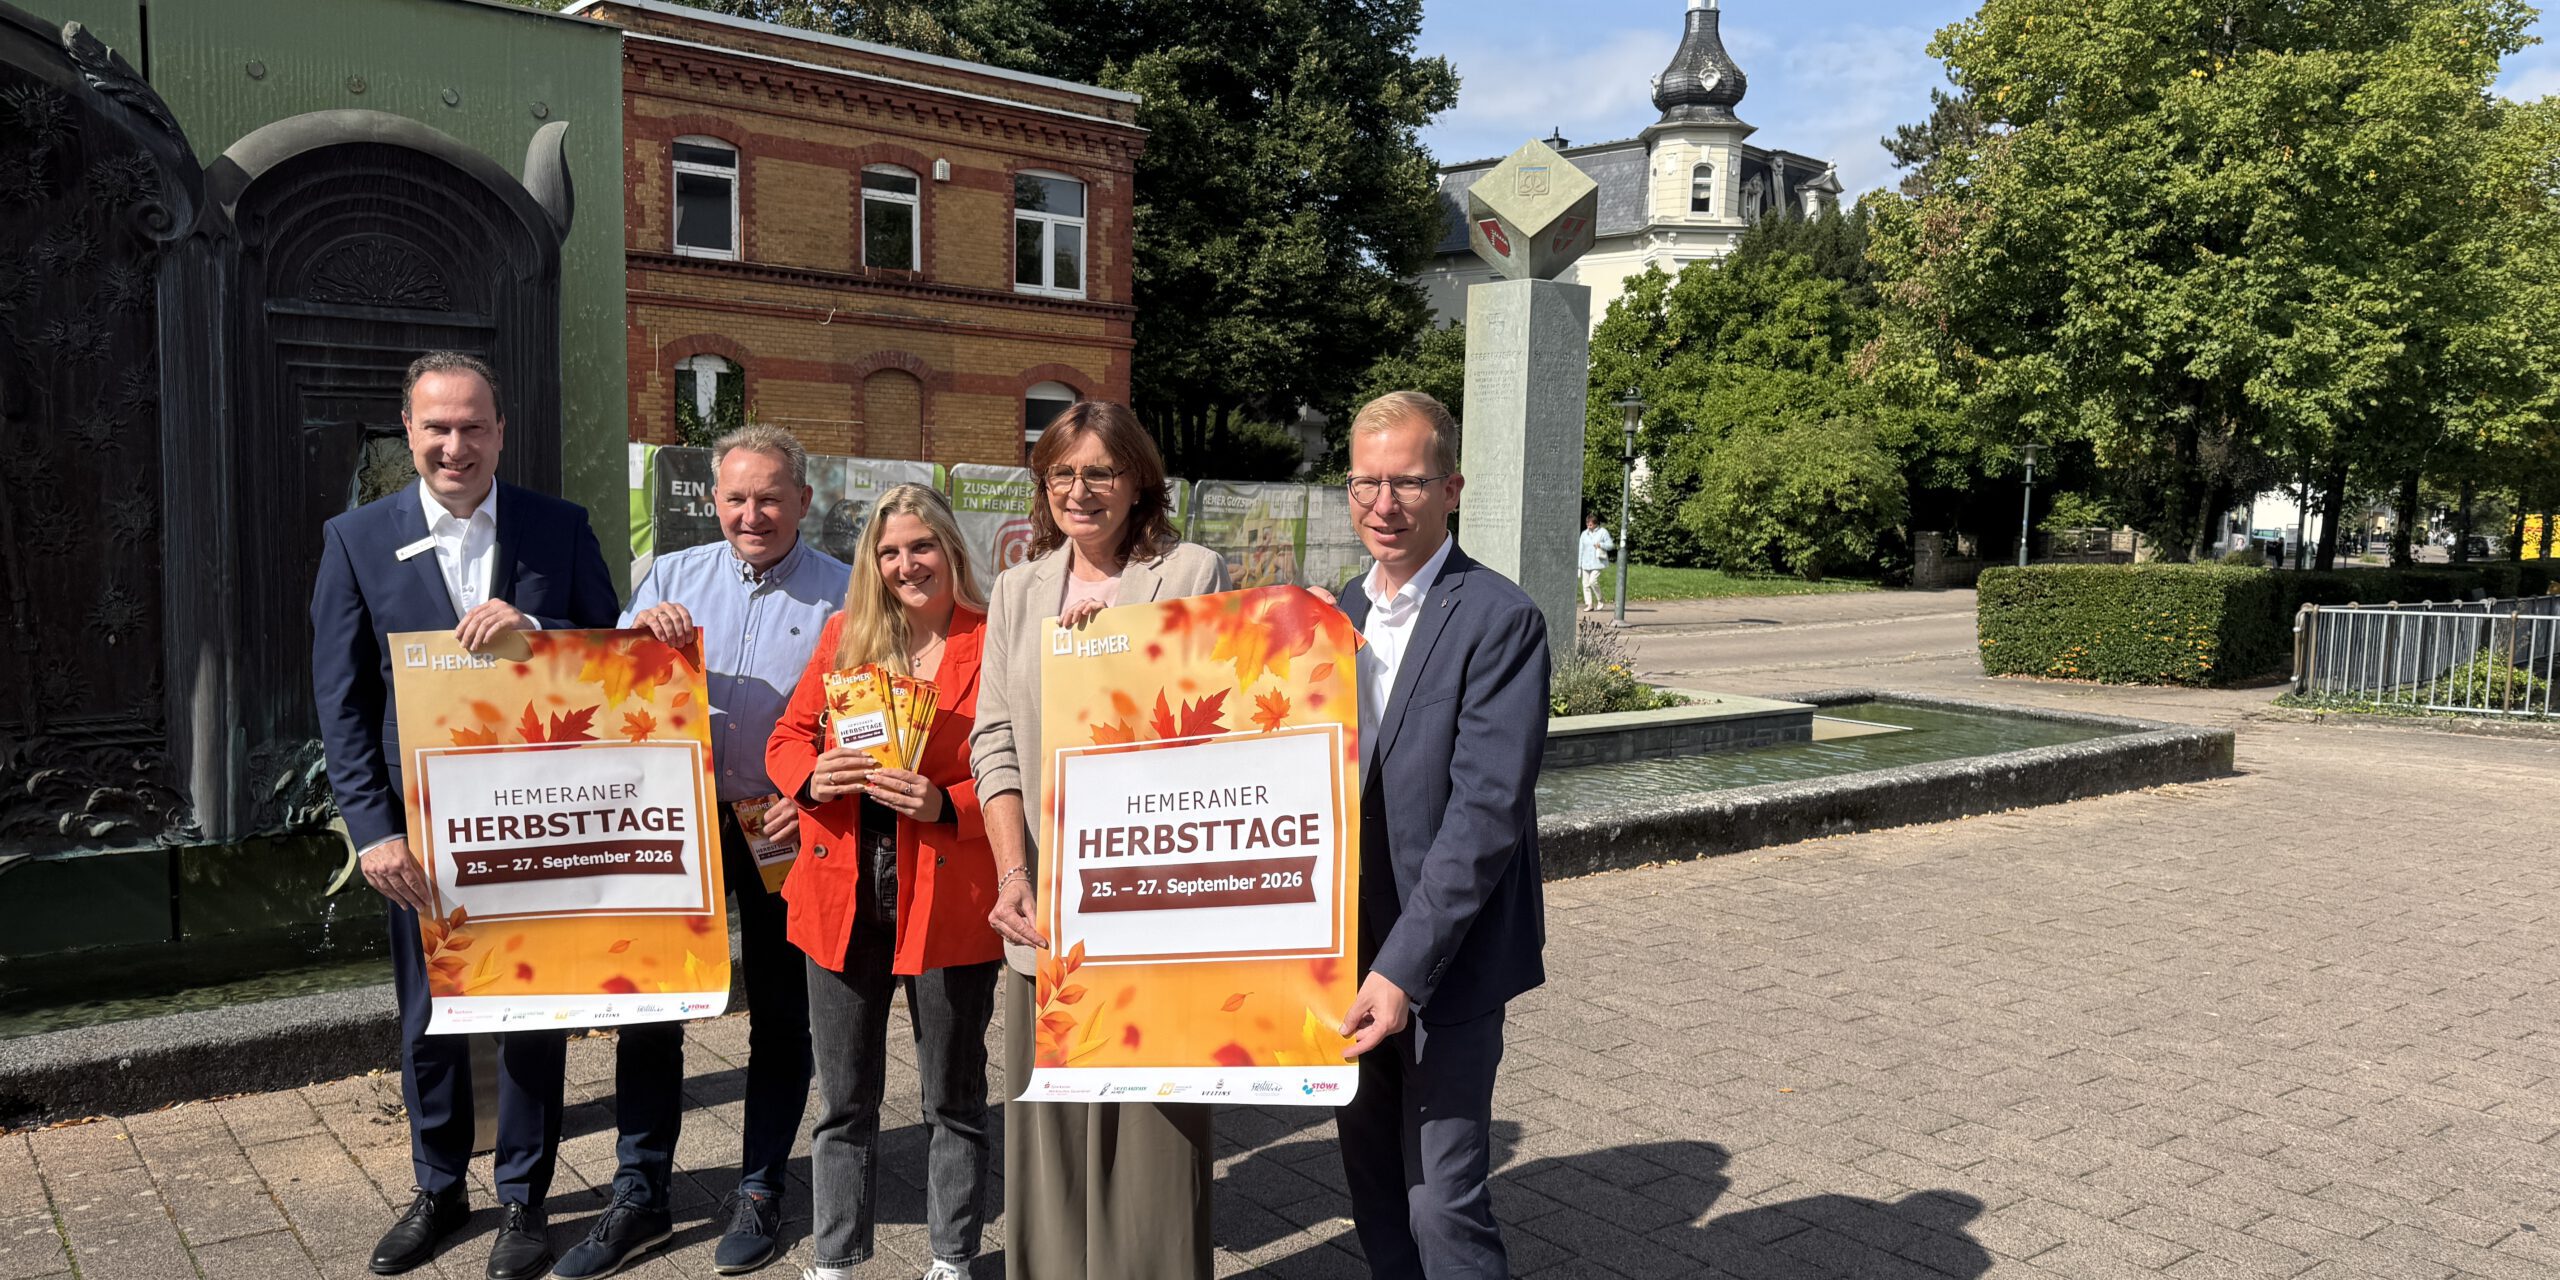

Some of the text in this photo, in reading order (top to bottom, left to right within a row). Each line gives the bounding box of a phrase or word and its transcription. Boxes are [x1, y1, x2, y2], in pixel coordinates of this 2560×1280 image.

[671, 480, 706, 497] EIN
[963, 497, 1026, 512] IN HEMER
[1077, 634, 1131, 658] HEMER
[431, 652, 497, 671] HEMER
[843, 674, 870, 685] HEMER
[494, 783, 638, 806] HEMERANER
[1127, 785, 1269, 814] HEMERANER
[448, 806, 685, 844] HERBSTTAGE
[1078, 813, 1320, 859] HERBSTTAGE
[466, 862, 493, 875] 25.
[512, 858, 538, 872] 27.
[542, 853, 631, 870] September
[634, 850, 673, 863] 2026
[1091, 881, 1117, 897] 25.
[1136, 880, 1162, 895] 27.
[1166, 875, 1257, 896] September
[1260, 872, 1303, 889] 2026
